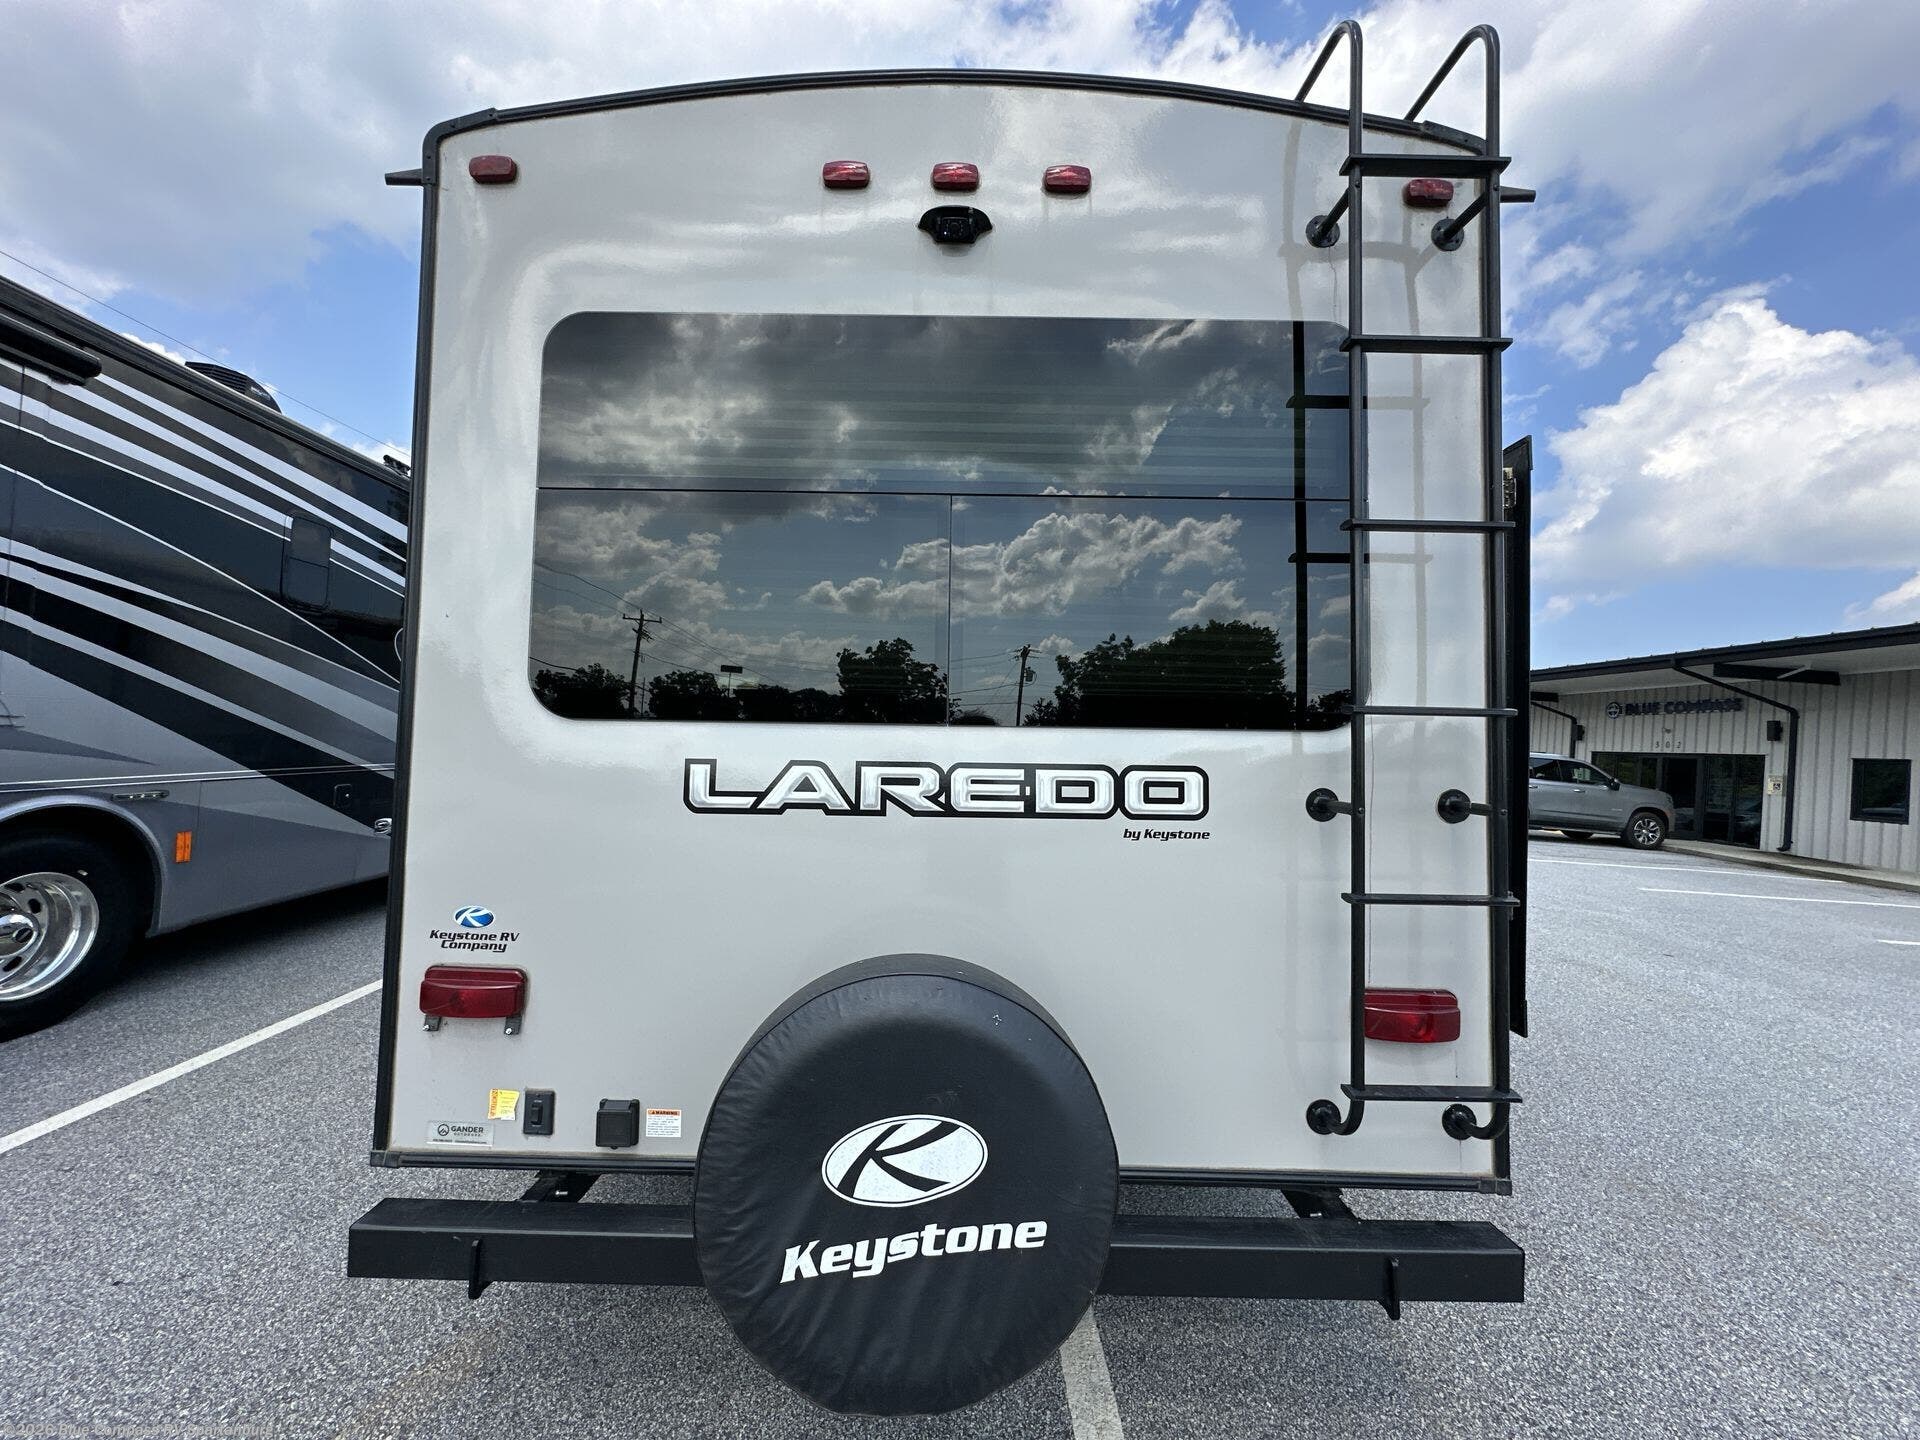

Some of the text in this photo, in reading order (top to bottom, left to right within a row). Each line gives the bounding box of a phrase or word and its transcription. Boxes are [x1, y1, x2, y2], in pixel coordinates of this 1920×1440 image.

[684, 758, 1210, 821] LAREDO
[1123, 828, 1211, 842] by Keystone
[429, 929, 520, 942] Keystone RV
[441, 939, 508, 953] Company
[450, 1125, 484, 1134] GANDER
[779, 1220, 1048, 1284] Keystone
